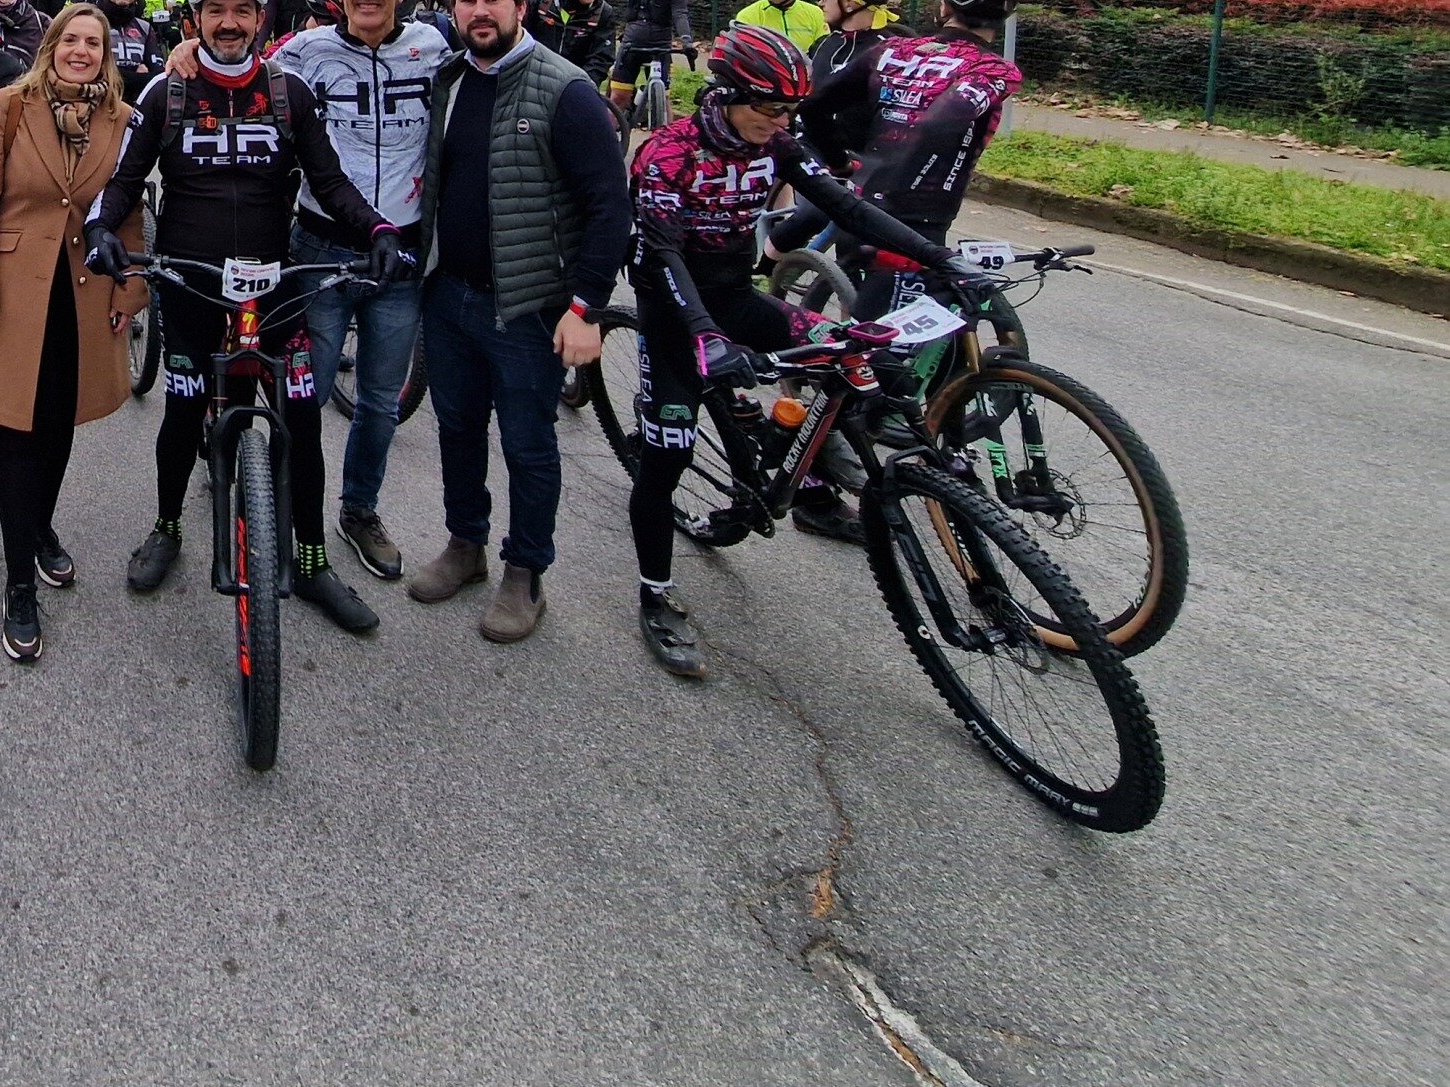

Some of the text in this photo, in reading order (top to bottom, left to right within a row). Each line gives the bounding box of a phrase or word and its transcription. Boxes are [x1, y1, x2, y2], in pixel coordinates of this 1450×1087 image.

[876, 48, 964, 79] HR
[879, 74, 934, 88] TEAM
[315, 76, 432, 116] HR
[891, 89, 923, 106] SILEA
[325, 116, 425, 130] TEAM
[182, 124, 280, 154] HR
[191, 155, 271, 165] TEAM
[942, 150, 967, 192] SINCE
[688, 156, 775, 193] HR
[699, 191, 768, 205] TEAM
[977, 255, 1004, 271] 49
[232, 277, 270, 292] 210
[902, 314, 939, 336] 45
[164, 371, 206, 397] EAM
[640, 353, 653, 402] SILEA
[797, 388, 830, 444] MOUNTAIN
[782, 438, 803, 474] ROCKY
[967, 719, 1071, 805] MAGIC MARY
